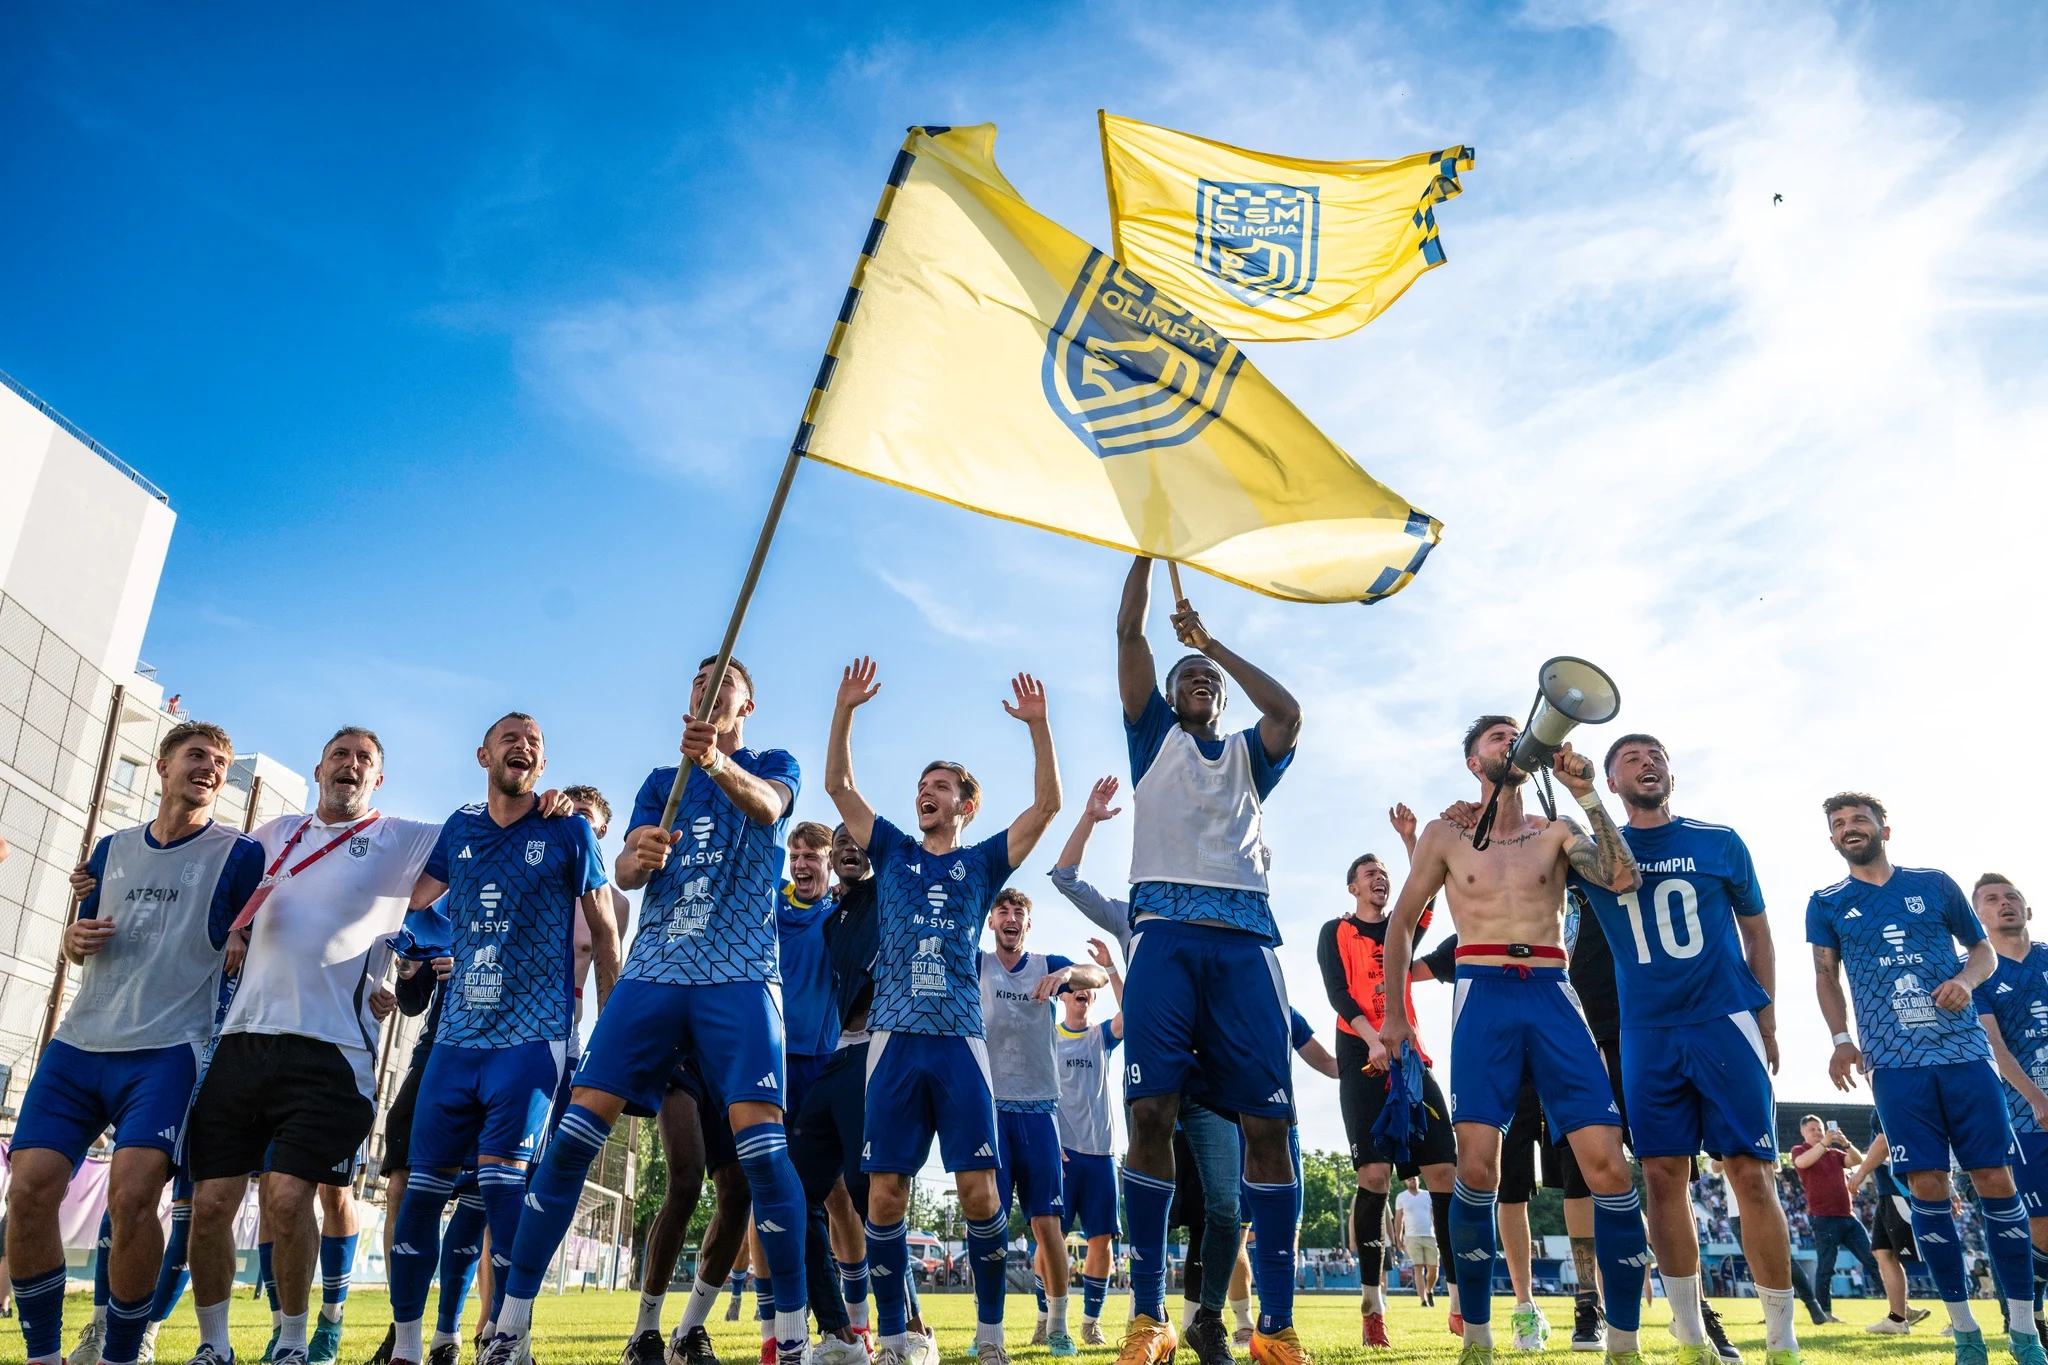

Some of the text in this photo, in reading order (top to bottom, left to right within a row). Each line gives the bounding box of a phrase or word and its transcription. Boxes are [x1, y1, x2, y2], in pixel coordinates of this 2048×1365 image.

[1215, 204, 1301, 225] CSM
[1214, 223, 1299, 237] OLIMPIA
[1101, 290, 1217, 353] OLIMPIA
[471, 920, 509, 933] M-SYS
[913, 914, 955, 930] M-SYS
[1617, 878, 1704, 964] 10
[912, 961, 927, 973] BEST
[1879, 953, 1923, 967] M-SYS
[465, 972, 503, 986] BEST BUILD
[1368, 971, 1384, 979] M-S
[464, 985, 502, 998] TECHNOLOGY
[996, 989, 1030, 1002] KIPSTA
[1892, 996, 1934, 1010] BEST BUILD
[2024, 1027, 2048, 1039] M-S
[1066, 1058, 1093, 1069] KIPSTA
[1126, 1063, 1142, 1086] 19
[861, 1141, 872, 1161] 4
[1891, 1144, 1909, 1163] 22
[2022, 1191, 2043, 1208] 11
